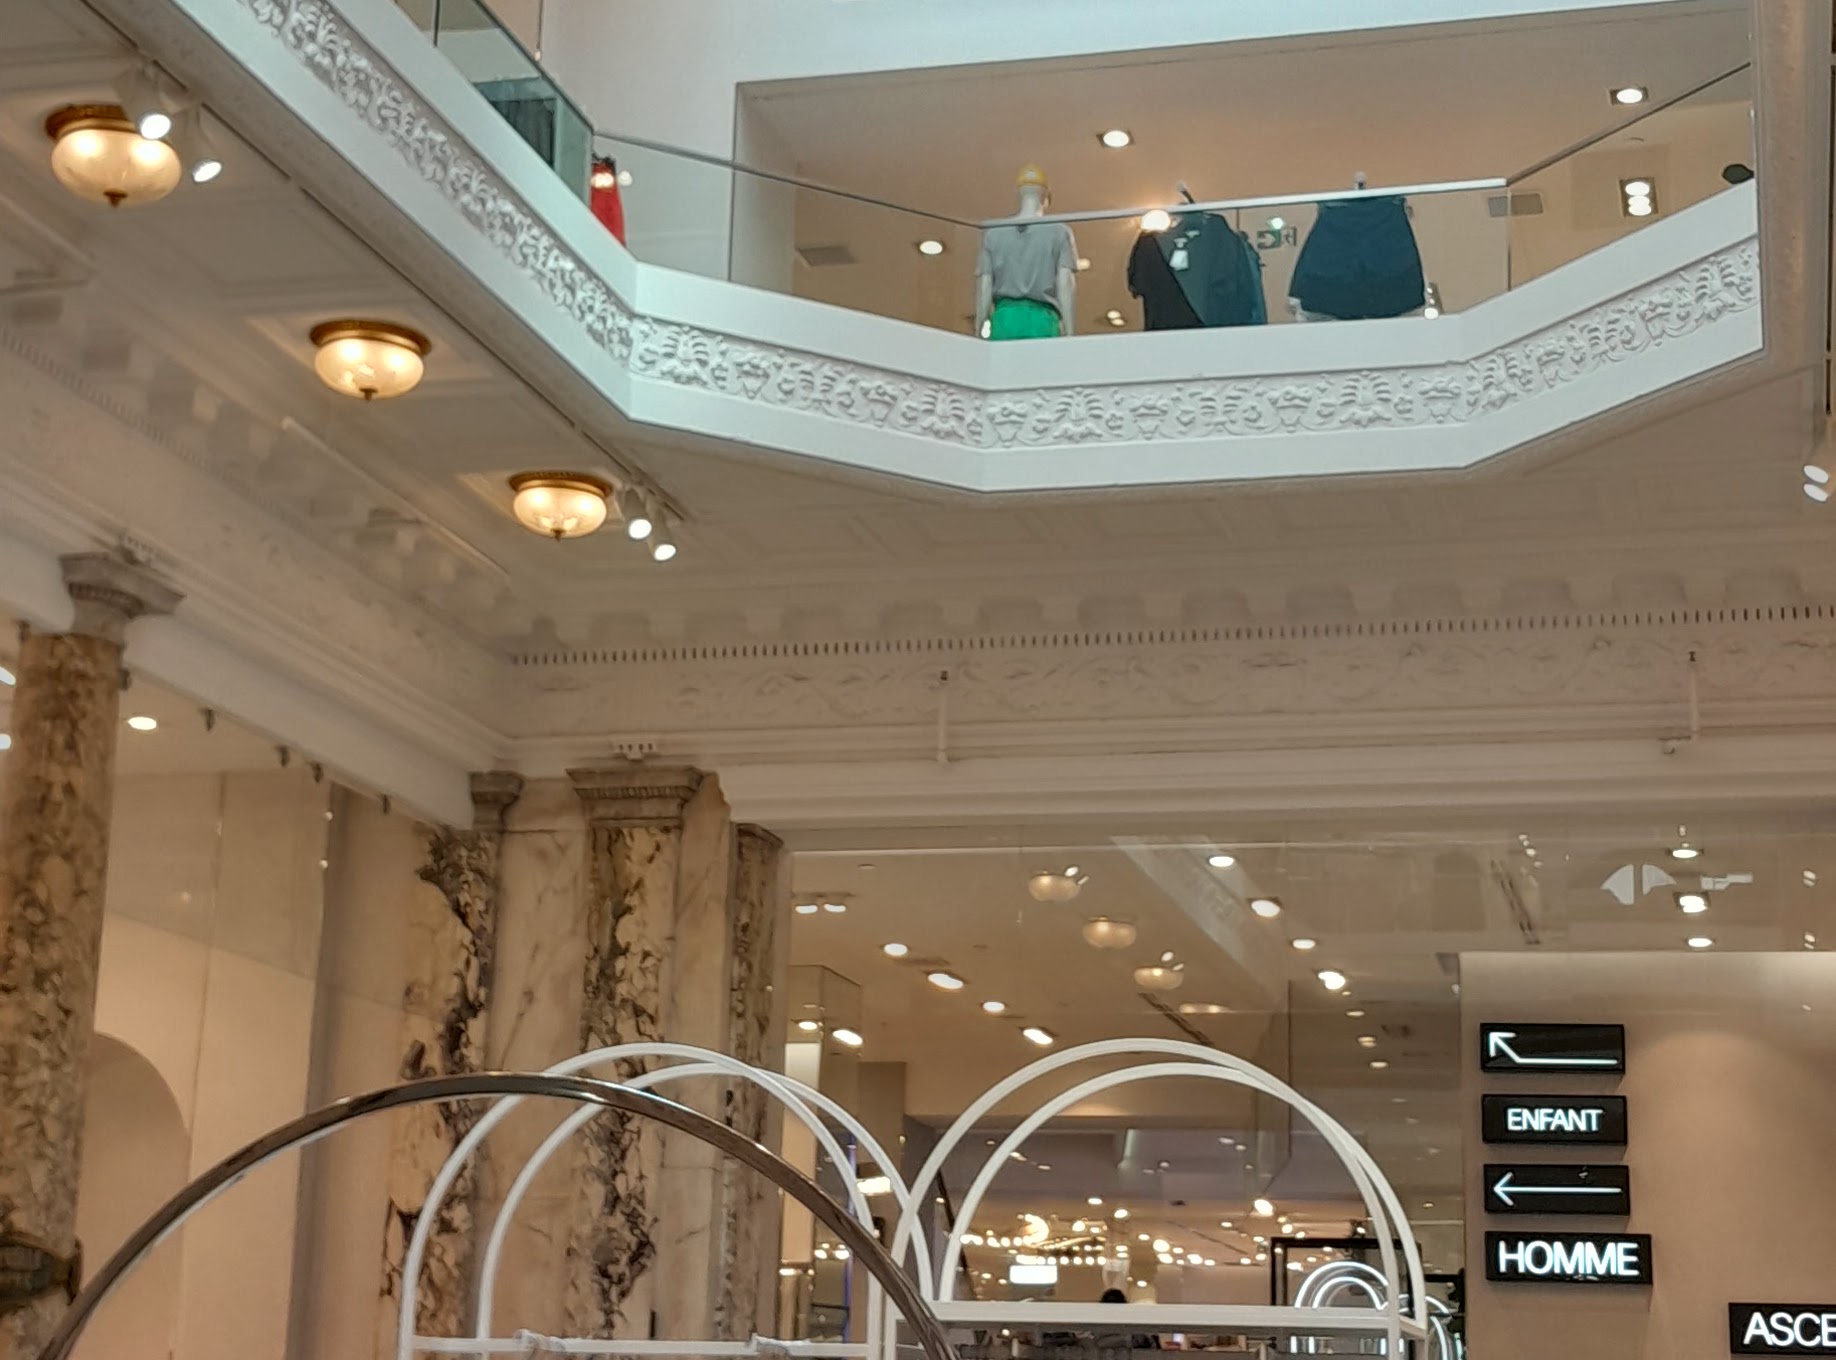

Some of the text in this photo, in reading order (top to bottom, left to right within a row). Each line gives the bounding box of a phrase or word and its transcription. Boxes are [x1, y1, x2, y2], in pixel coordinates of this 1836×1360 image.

[1507, 1108, 1604, 1132] ENFANT
[1498, 1240, 1641, 1277] HOMME
[1743, 1311, 1836, 1347] ASCE
